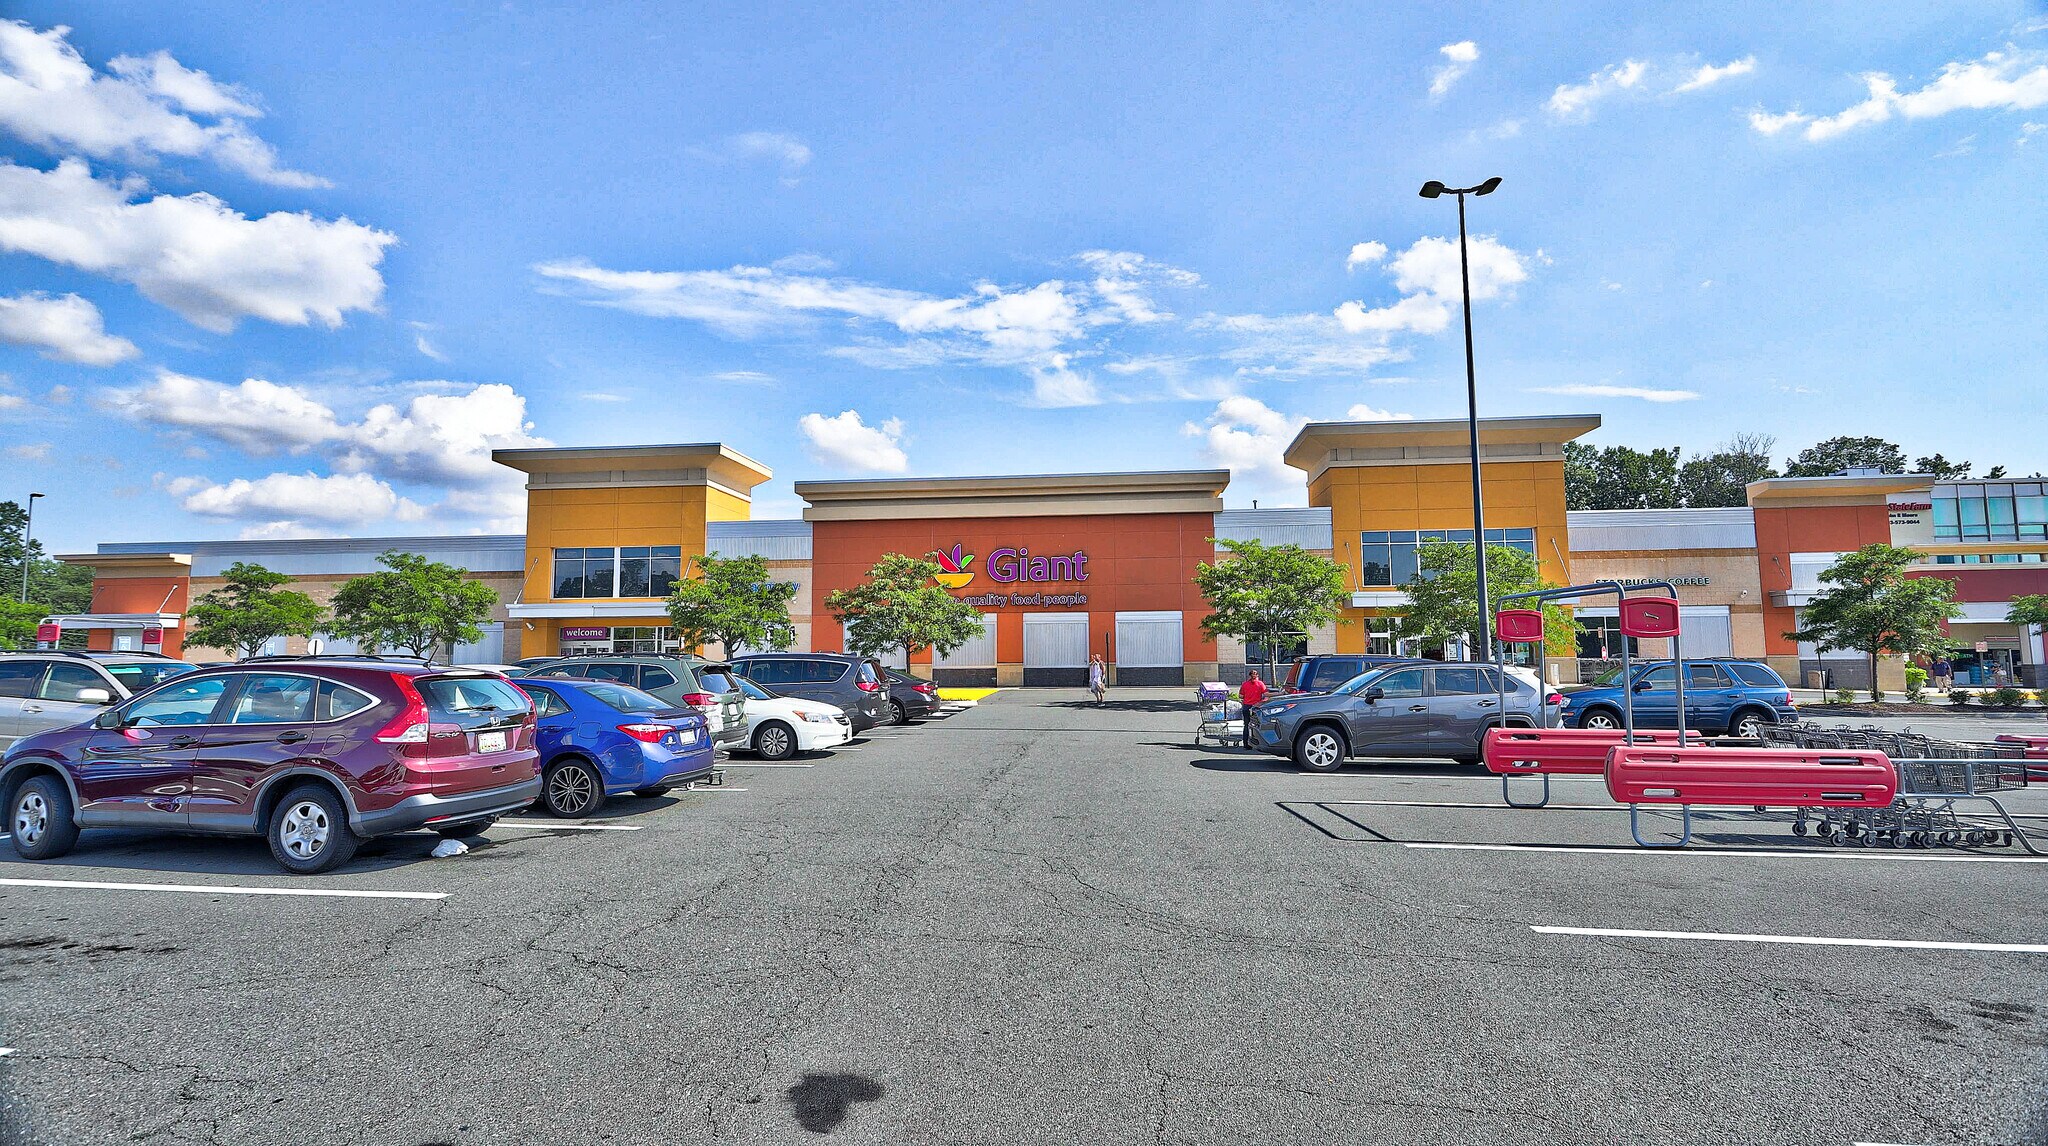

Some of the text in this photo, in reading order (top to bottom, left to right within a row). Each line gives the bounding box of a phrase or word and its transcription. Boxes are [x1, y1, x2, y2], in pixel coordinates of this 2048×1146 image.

[987, 548, 1089, 582] Giant
[1595, 577, 1710, 586] STRBUCKS COFFEE
[963, 594, 1007, 608] quality
[566, 627, 603, 636] welcome
